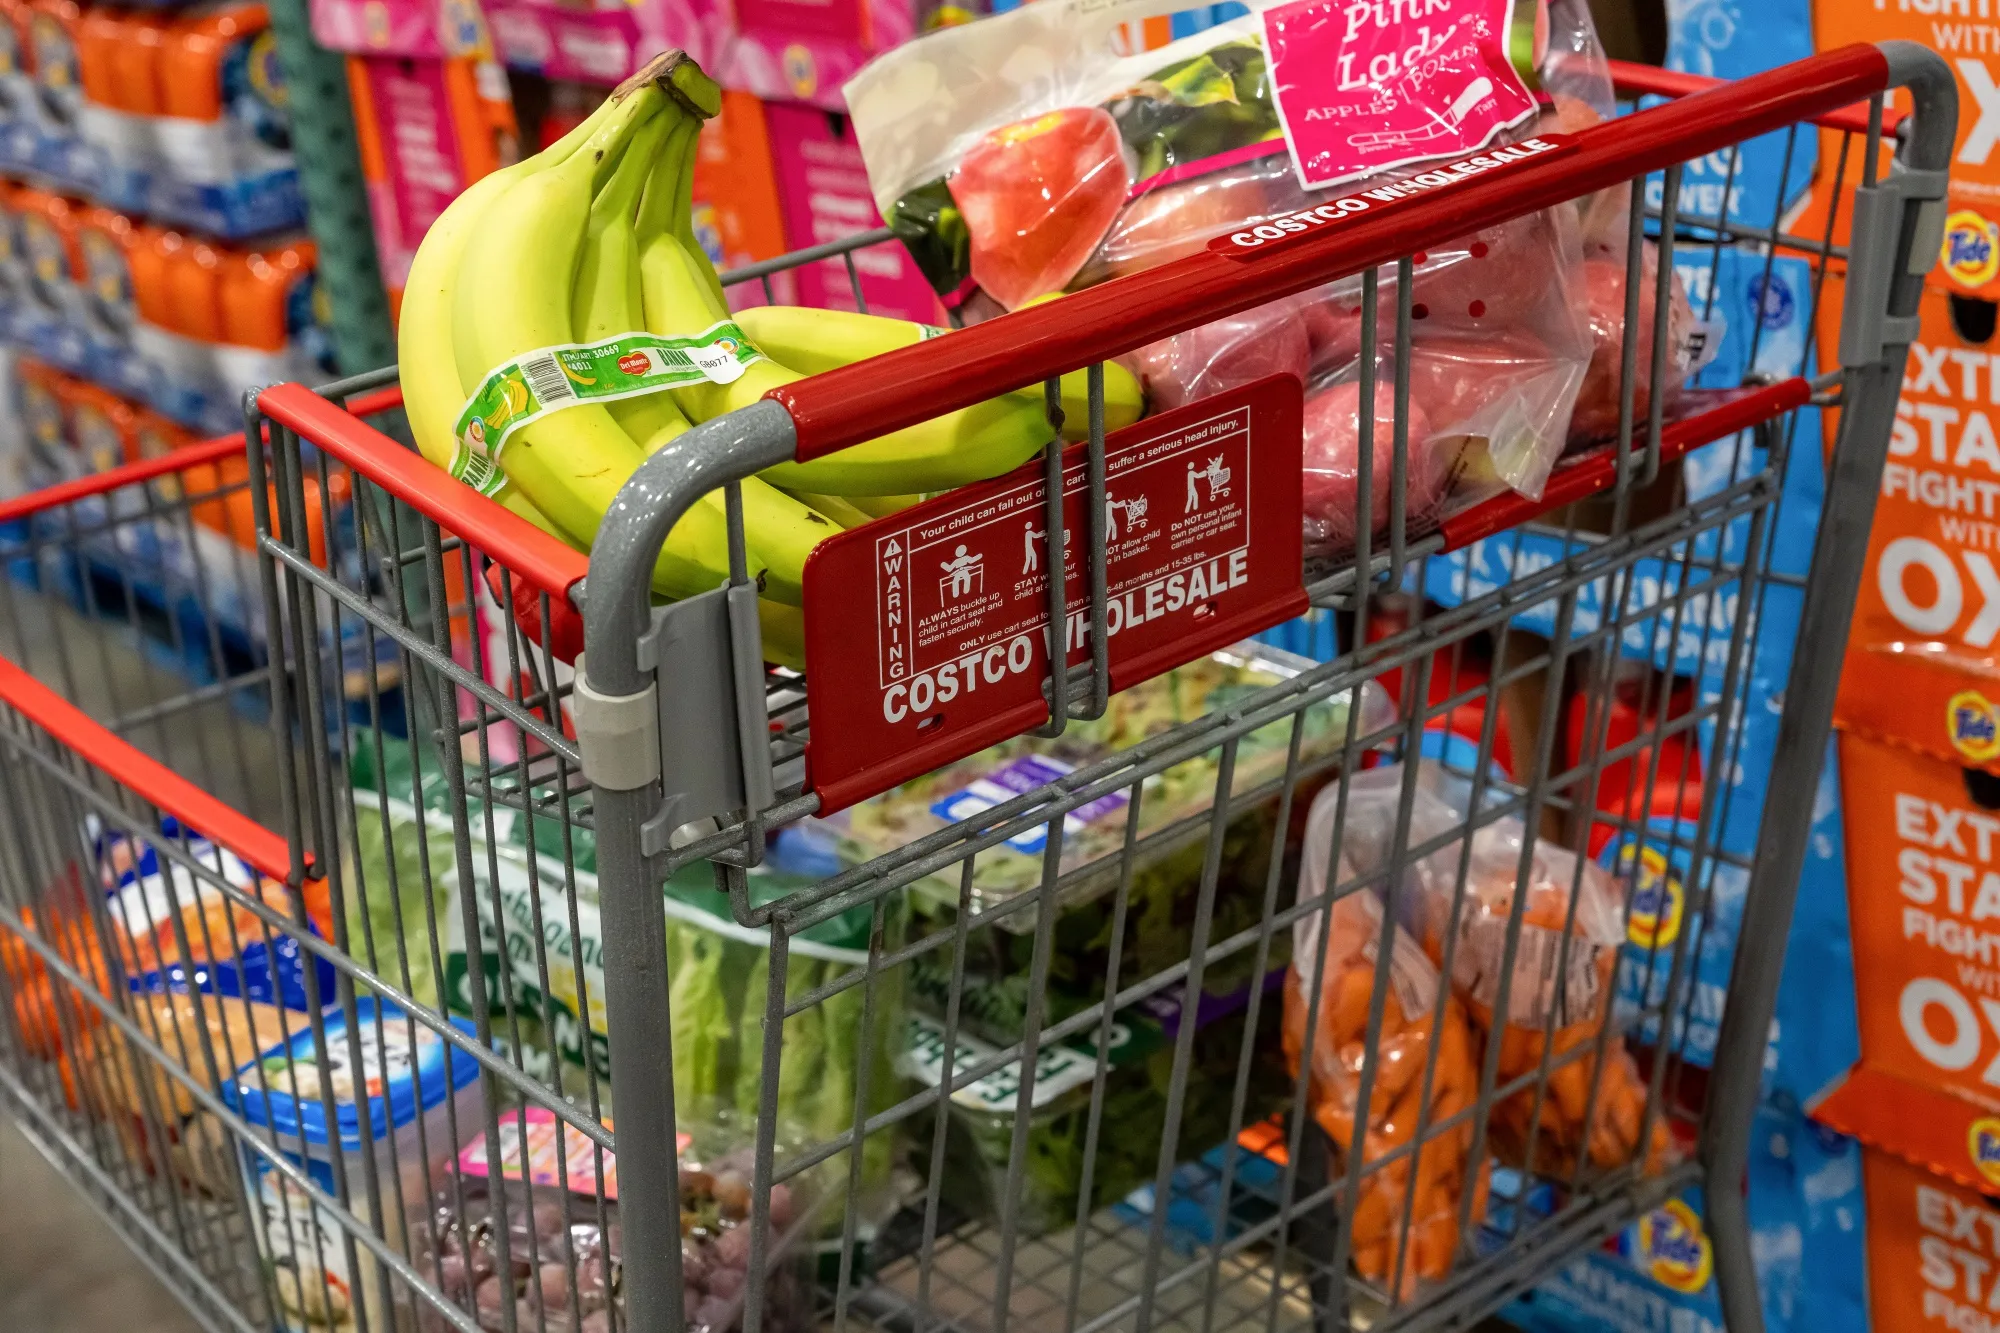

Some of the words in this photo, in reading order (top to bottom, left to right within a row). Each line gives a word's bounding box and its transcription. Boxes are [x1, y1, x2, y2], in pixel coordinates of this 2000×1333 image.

[1342, 0, 1452, 43] Pink
[1931, 20, 2000, 54] WIT
[1337, 24, 1457, 92] Lady
[1304, 94, 1399, 122] APPLES
[1230, 197, 1368, 248] COSTCO
[1362, 138, 1559, 203] WHOLESALE
[1948, 228, 1991, 265] Tide
[592, 344, 620, 359] 30669
[619, 362, 631, 370] Del
[629, 358, 649, 367] Monte
[919, 523, 946, 540] Your
[948, 510, 975, 531] child
[976, 506, 996, 518] can
[998, 497, 1014, 512] fall
[1016, 492, 1033, 505] out
[1066, 472, 1086, 487] cart
[1108, 453, 1137, 472] suffer
[1138, 450, 1146, 460] a
[1146, 438, 1183, 458] serious
[1184, 428, 1208, 444] head
[1209, 418, 1239, 437] injury.
[1171, 521, 1182, 532] Do
[1184, 513, 1203, 527] NOT
[1203, 509, 1217, 519] use
[1218, 502, 1236, 516] your
[1171, 529, 1187, 541] own
[1188, 518, 1216, 536] personal
[1217, 508, 1242, 524] infant
[1938, 512, 2000, 552] WIT
[1121, 537, 1142, 552] allow
[1142, 529, 1161, 544] child
[1122, 543, 1151, 560] basket.
[1171, 535, 1196, 550] carrier
[1196, 531, 1205, 540] or
[1205, 526, 1218, 537] car
[1219, 520, 1237, 532] seat.
[1014, 575, 1039, 591] STAY
[1014, 585, 1034, 601] child
[1035, 583, 1044, 594] at
[883, 555, 904, 679] WARNING
[918, 605, 959, 628] ALWAYS
[960, 596, 988, 612] buckle
[989, 591, 1001, 604] up
[959, 635, 985, 652] ONLY
[986, 629, 1002, 641] use
[1003, 623, 1020, 636] cart
[1021, 615, 1039, 629] seat
[1106, 580, 1124, 595] 6-48
[1125, 571, 1153, 588] months
[1154, 563, 1169, 577] and
[1171, 554, 1192, 571] 15-35
[1193, 549, 1207, 563] lbs.
[918, 622, 937, 638] child
[939, 619, 949, 631] in
[950, 613, 966, 626] cart
[967, 606, 986, 620] seat
[987, 598, 1003, 613] and
[918, 630, 945, 647] fasten
[946, 617, 985, 637] securely.
[883, 634, 1033, 724] COSTCO
